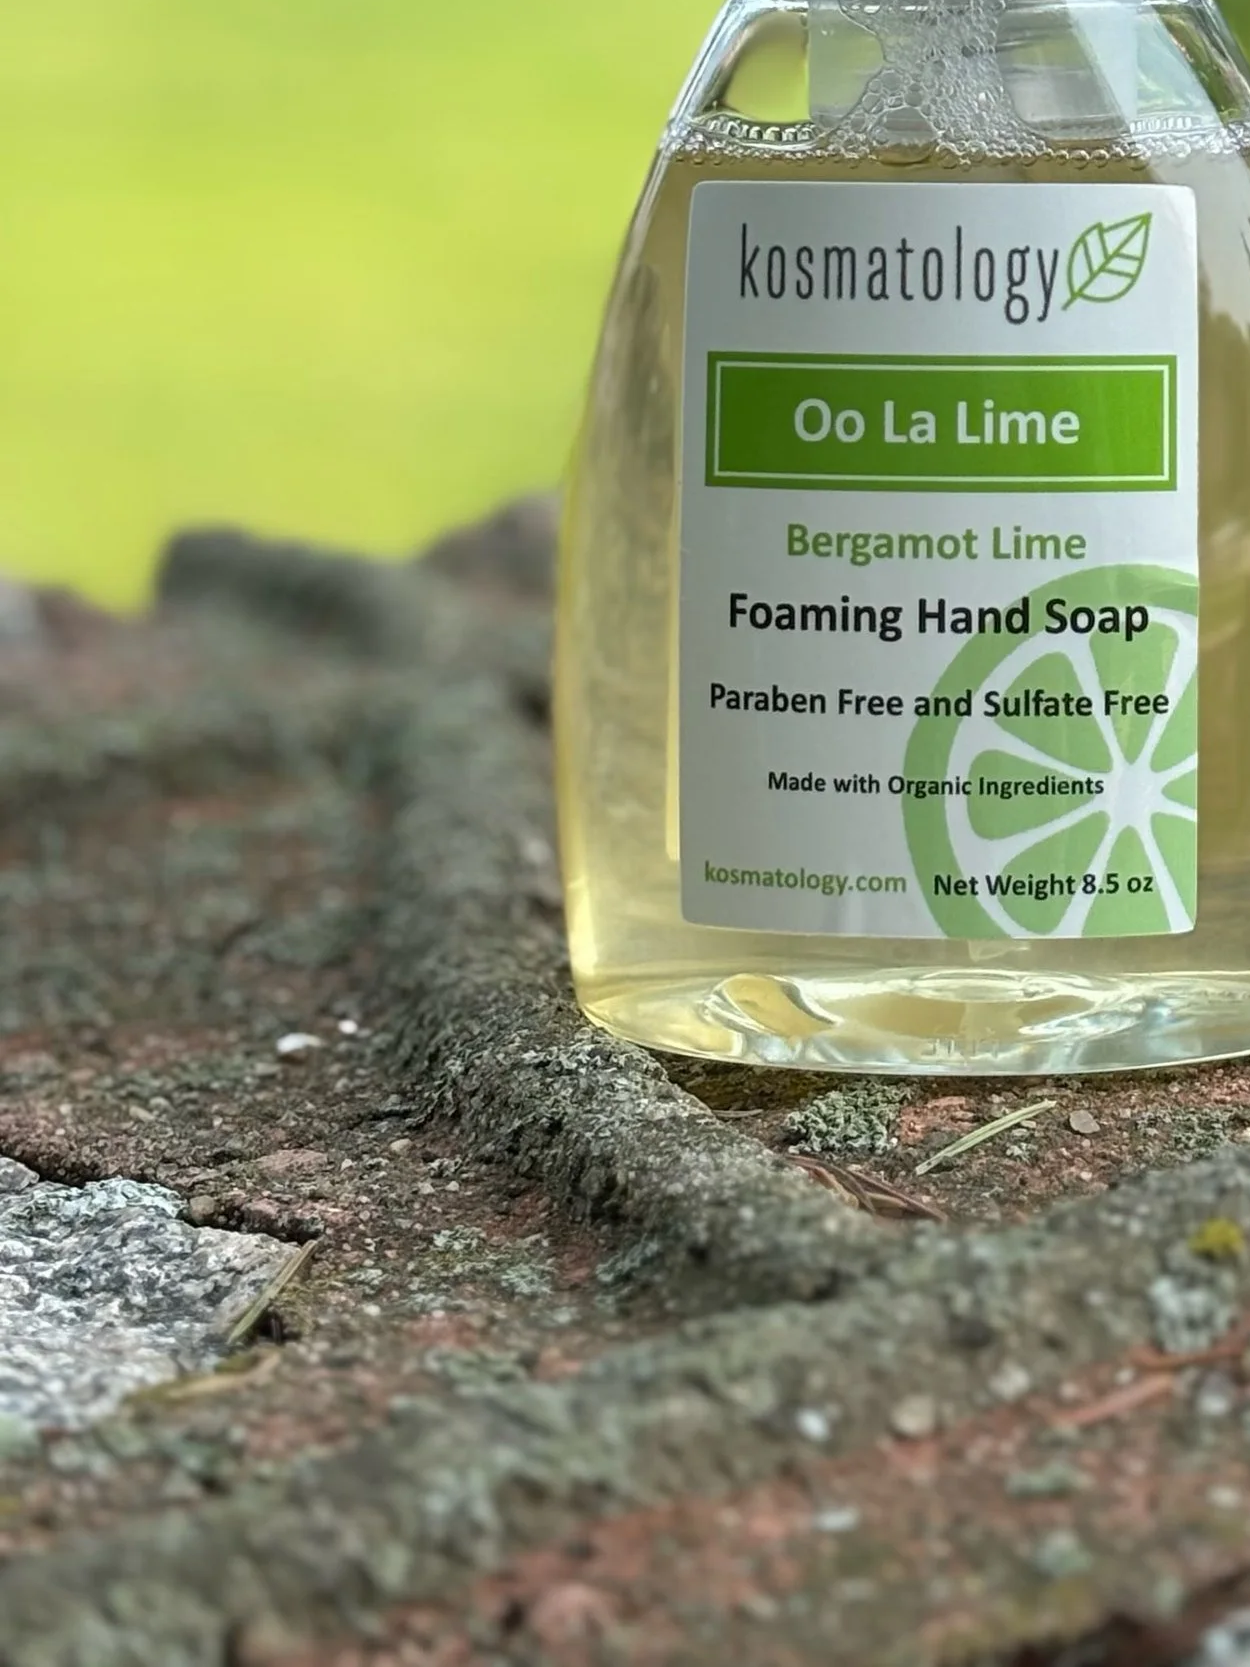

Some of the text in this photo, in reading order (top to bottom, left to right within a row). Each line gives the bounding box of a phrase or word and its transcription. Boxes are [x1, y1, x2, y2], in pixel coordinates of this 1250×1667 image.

[739, 222, 1060, 325] kosmatology
[793, 397, 1081, 446] Oo La Lime
[786, 523, 1088, 567] Bergamot Lime
[728, 592, 1150, 642] Foaming Hand Soap
[709, 682, 1170, 718] Paraben Free and Sulfate Free
[767, 771, 1106, 800] Made with Organic Ingredients
[703, 861, 908, 897] kosmatology.com
[933, 873, 1154, 901] Net Weight 8.5 oz
